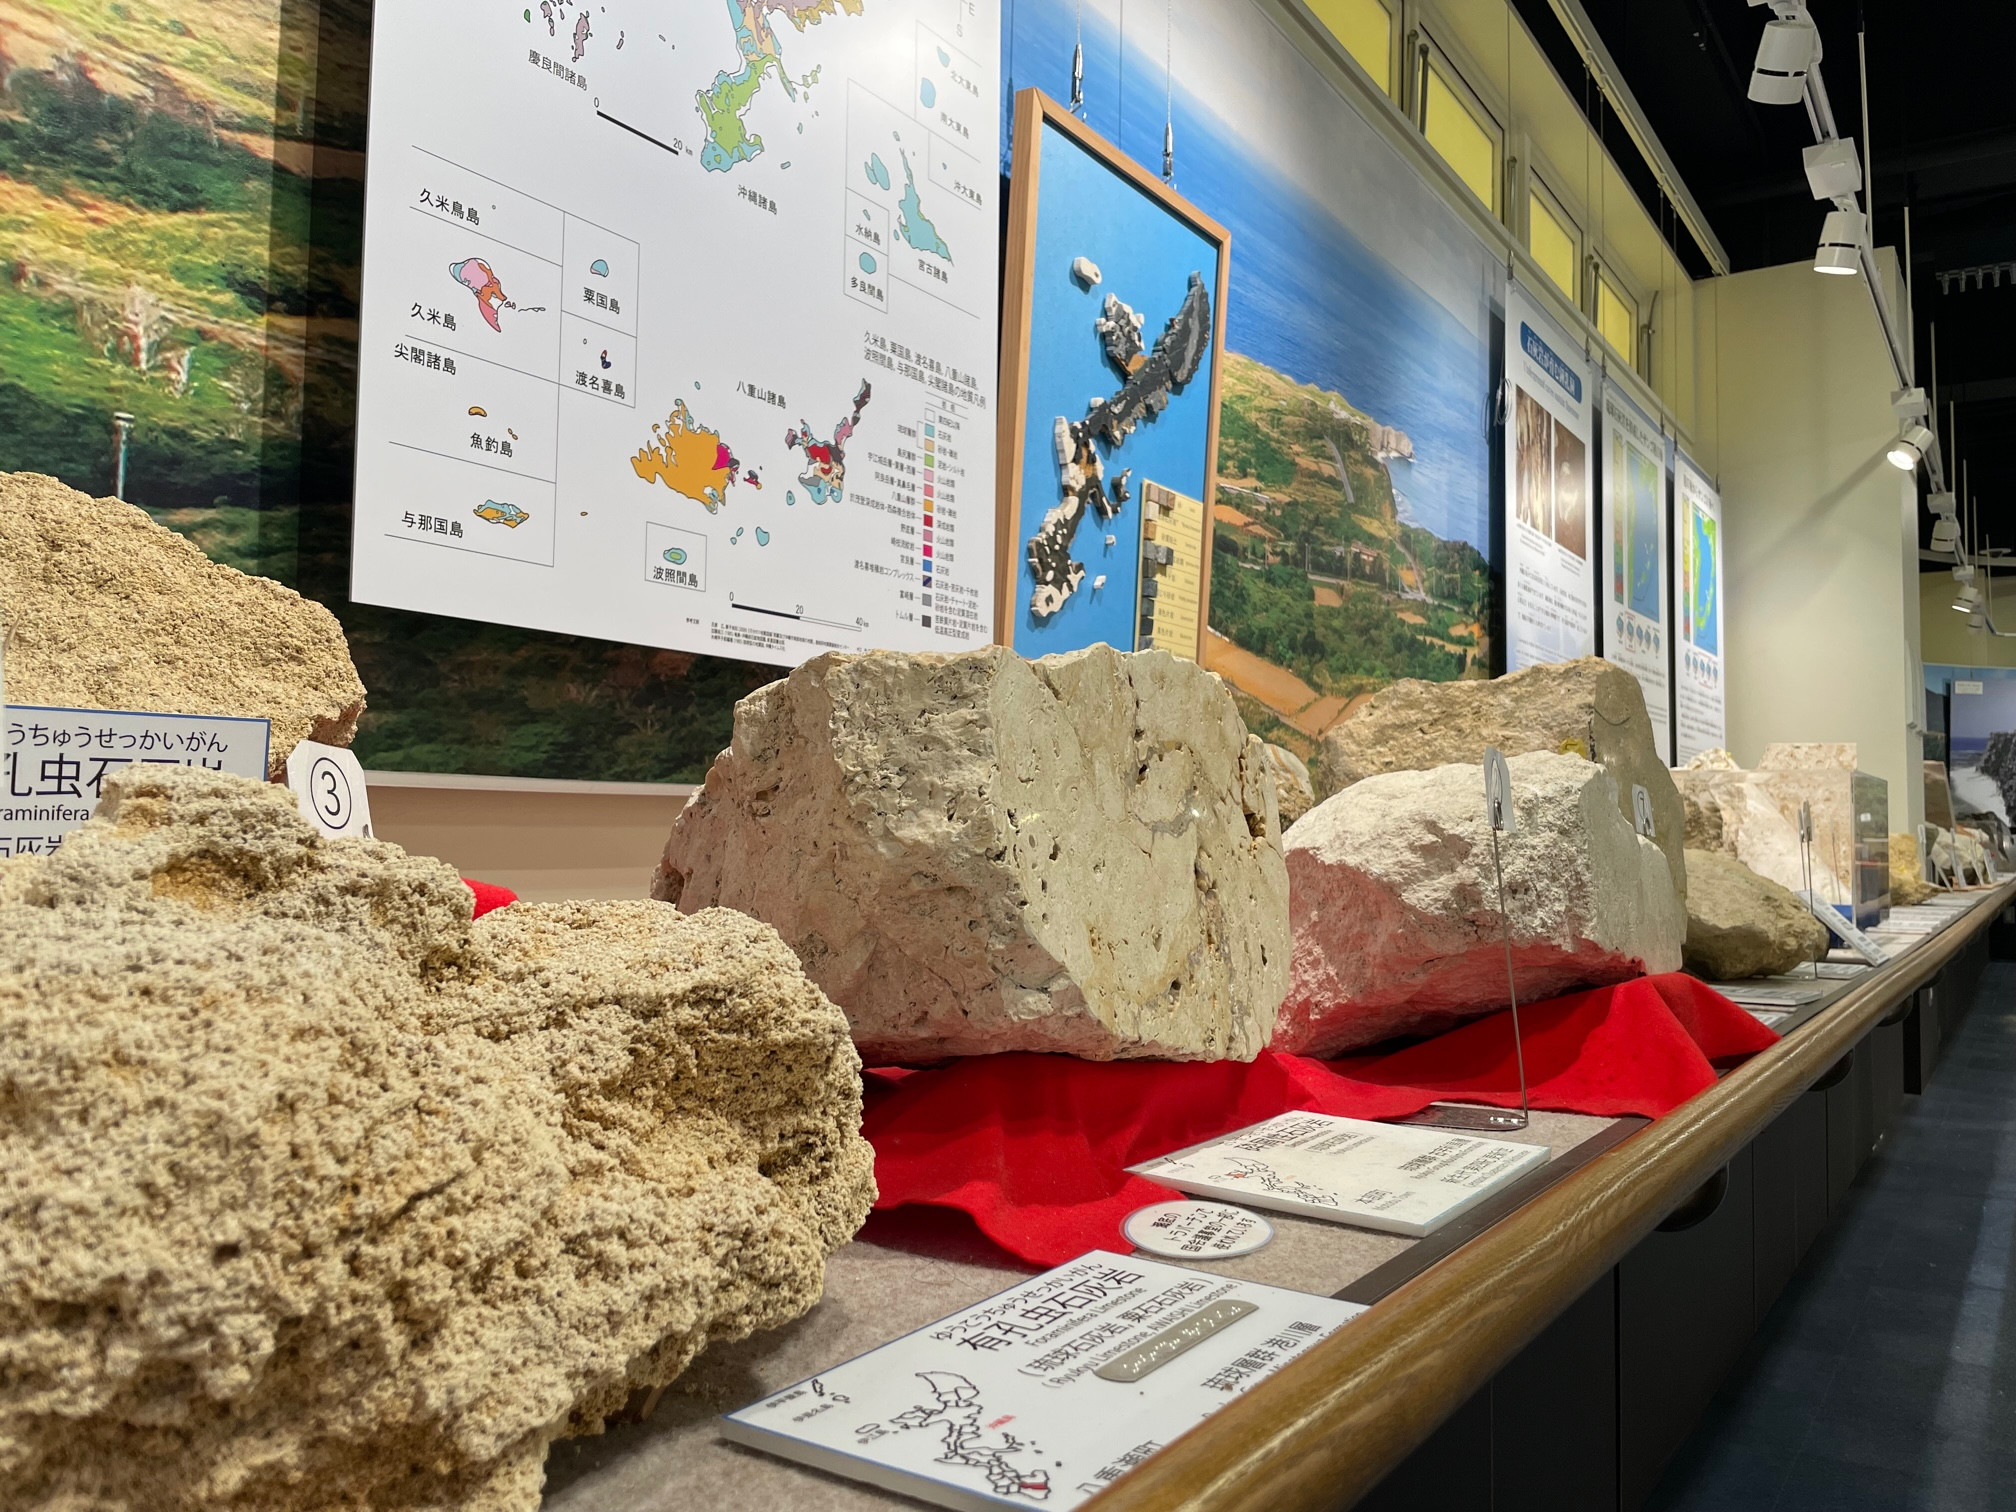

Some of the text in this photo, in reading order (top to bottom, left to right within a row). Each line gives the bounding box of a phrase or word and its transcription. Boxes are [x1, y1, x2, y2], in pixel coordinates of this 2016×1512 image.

[528, 49, 588, 91] 慶良間諸島
[673, 137, 683, 151] 20
[737, 184, 778, 215] 沖縄諸島
[855, 223, 881, 246] 水納島
[917, 258, 948, 284] 宮古諸島
[851, 276, 884, 302] 多良間島
[411, 302, 457, 332] 久米島
[394, 342, 457, 375] 尖閣諸島
[575, 370, 626, 400] 渡名喜島
[736, 380, 787, 409] 八重山諸島
[470, 432, 513, 458] 魚釣島
[401, 510, 464, 539] 与那国島
[653, 565, 698, 588] 波照間島
[729, 591, 735, 602] 0
[795, 604, 804, 615] 20
[856, 616, 863, 627] 40
[956, 1267, 1145, 1351] 有孔虫石灰岩
[1025, 1287, 1148, 1347] Foraminifera Limestone
[1201, 1347, 1281, 1391] 琉球層群
[1260, 1321, 1322, 1352] 港川層
